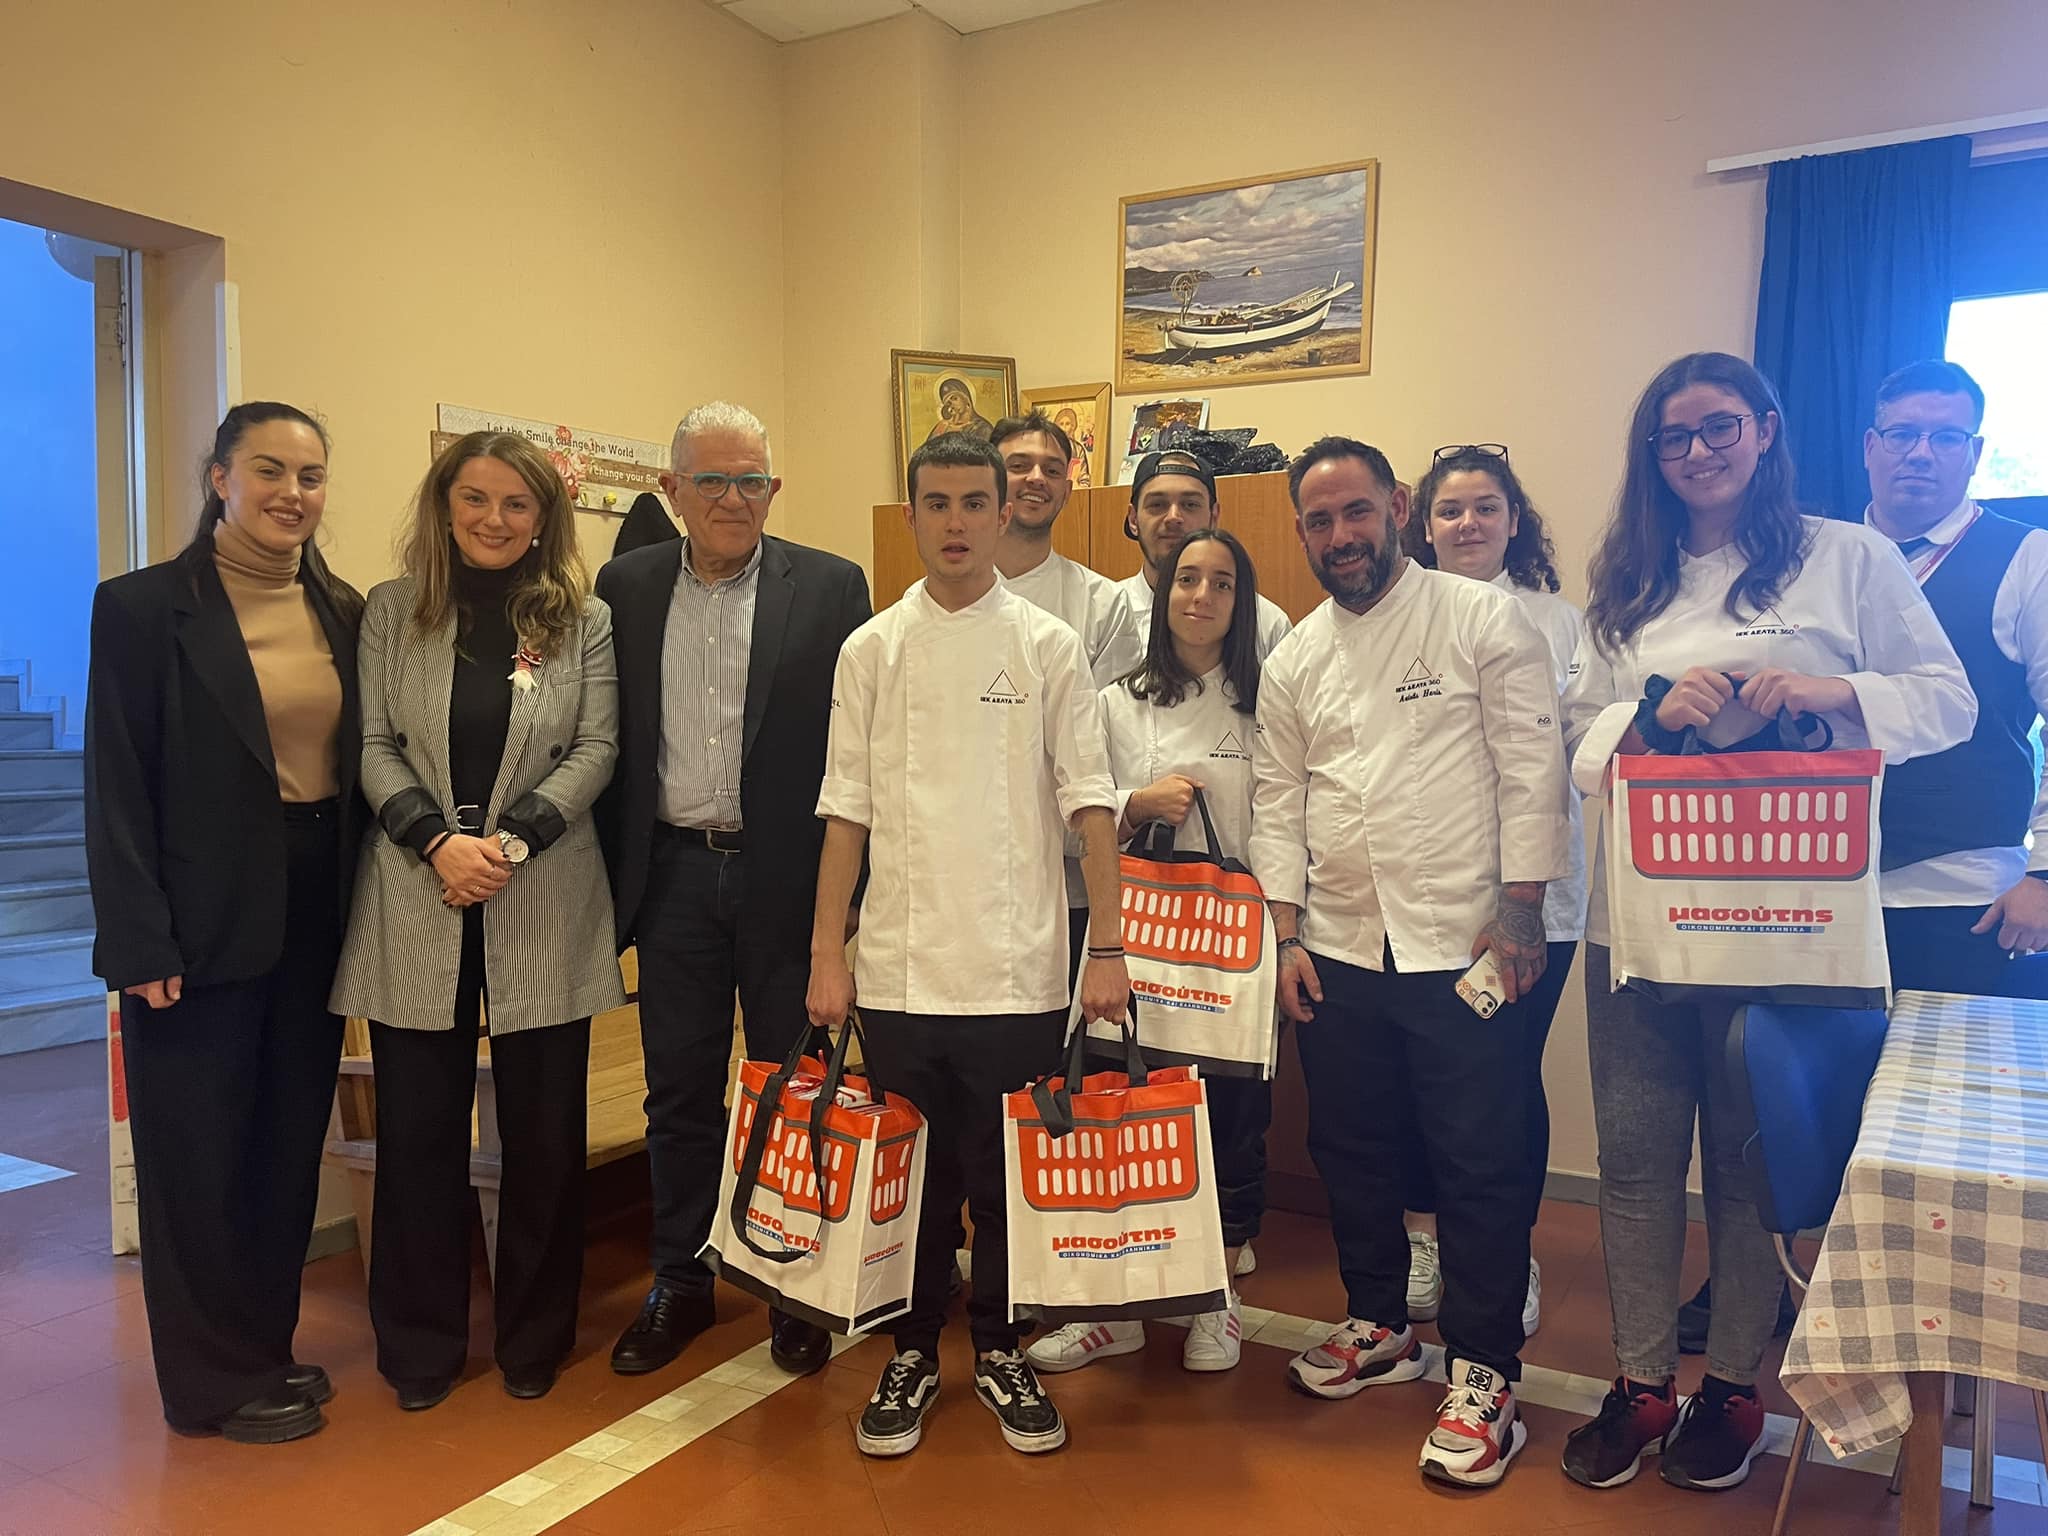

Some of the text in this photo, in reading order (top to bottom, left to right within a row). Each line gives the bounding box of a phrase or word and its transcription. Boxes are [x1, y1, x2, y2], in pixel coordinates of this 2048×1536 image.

[526, 429, 553, 443] Smile
[556, 436, 589, 451] change
[590, 442, 606, 454] the
[608, 443, 634, 458] World
[594, 465, 624, 481] change
[625, 472, 644, 483] your
[1669, 905, 1833, 923] μασούτης
[1129, 979, 1232, 1005] ασούτης
[1052, 1227, 1177, 1251] μασούτης
